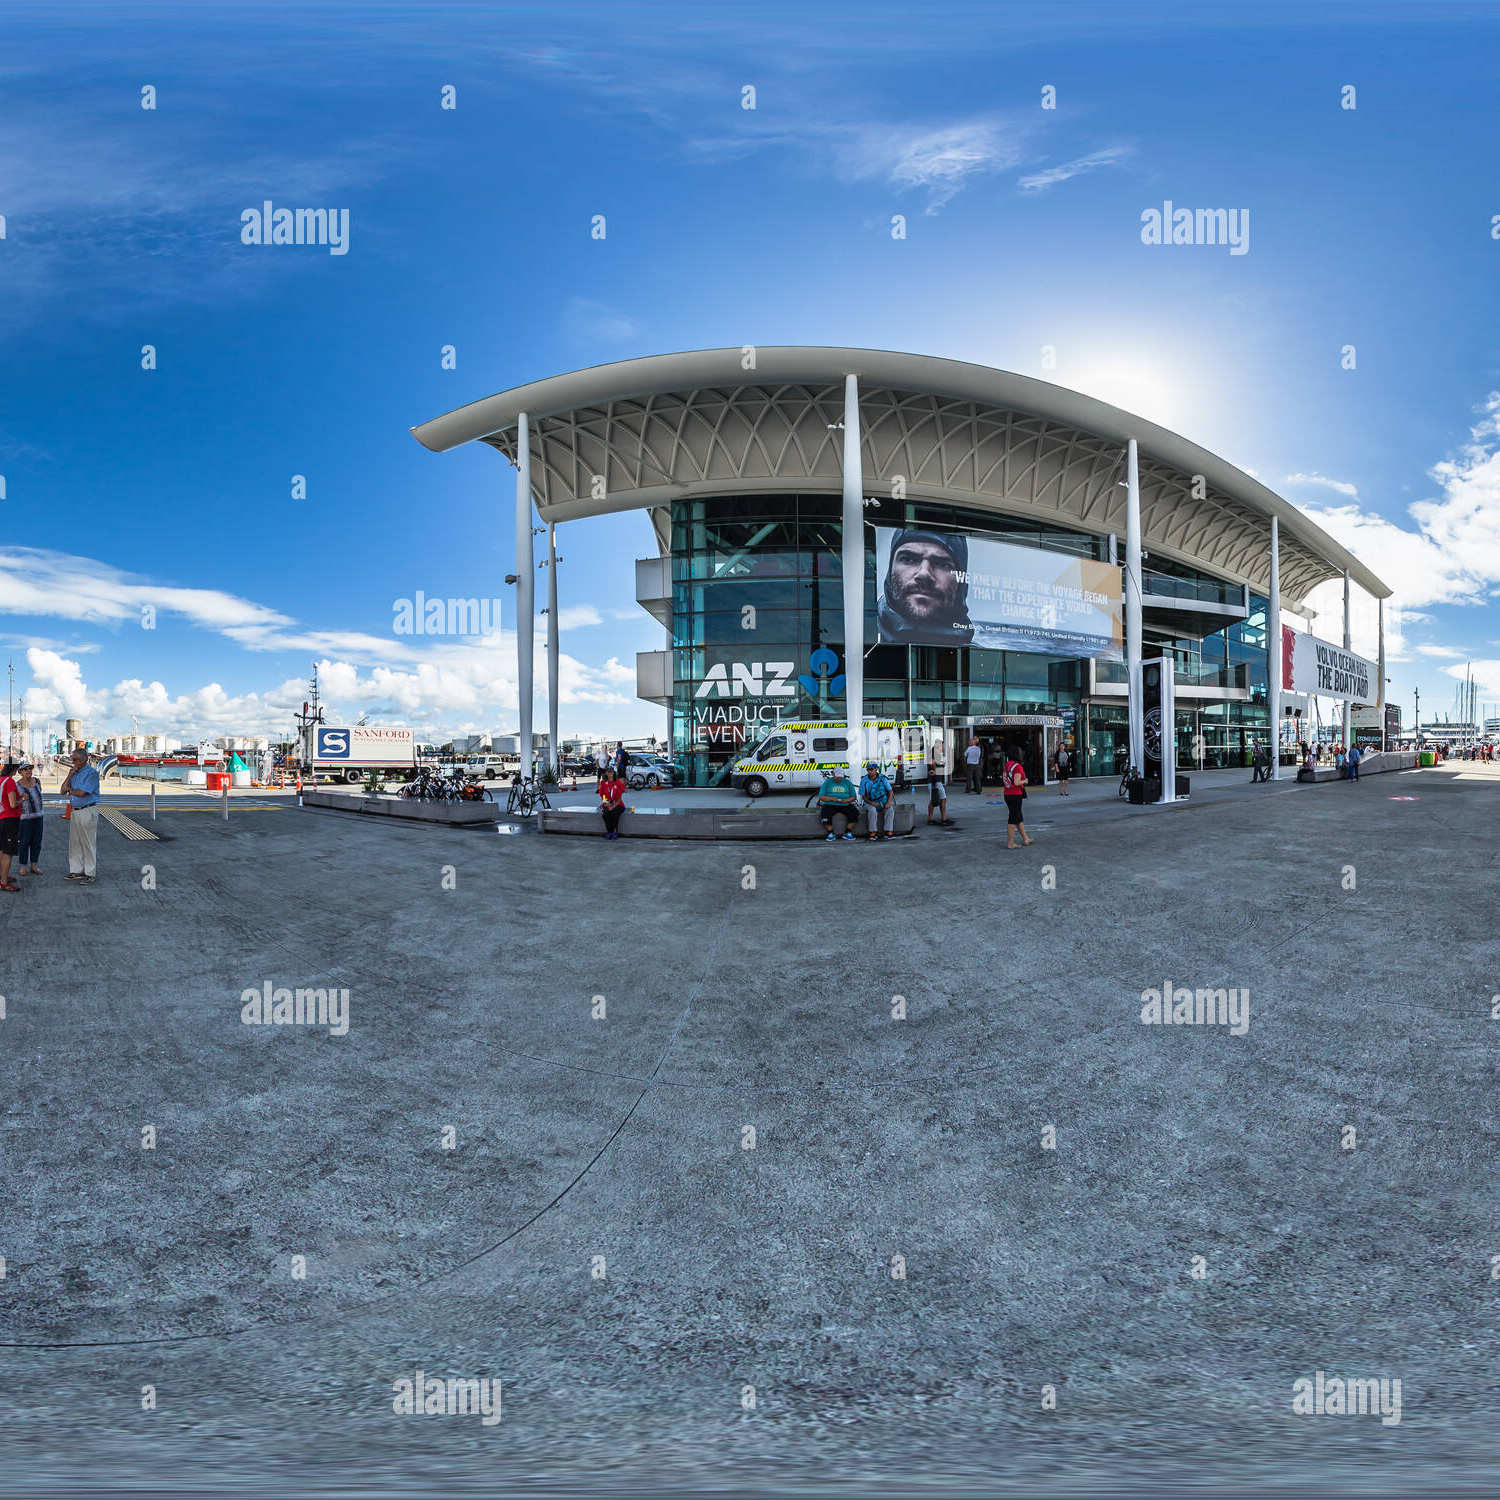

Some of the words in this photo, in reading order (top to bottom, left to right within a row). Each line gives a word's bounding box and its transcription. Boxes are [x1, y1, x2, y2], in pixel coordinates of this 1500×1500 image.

[972, 573, 999, 587] KNEW
[1002, 576, 1034, 591] BEFORE
[1036, 582, 1050, 595] THE
[1052, 585, 1083, 600] VOYAGE
[1084, 590, 1108, 605] BEGAN
[972, 586, 996, 600] THAT
[1000, 590, 1016, 603] THE
[1016, 592, 1064, 610] EXPERIENCE
[1066, 600, 1092, 615] WOULD
[1002, 604, 1035, 618] CHANGE
[952, 622, 968, 630] Chay
[1052, 632, 1067, 640] United
[1068, 633, 1086, 642] Friendly
[1316, 644, 1338, 669] VOLVO
[1338, 653, 1356, 674] OCEAN
[1356, 660, 1368, 679] RACE
[695, 662, 796, 698] ANZ
[1316, 664, 1332, 691] THE
[1334, 669, 1368, 698] BOATYARD
[695, 705, 784, 723] VIADUCT
[354, 728, 410, 738] SANFORD
